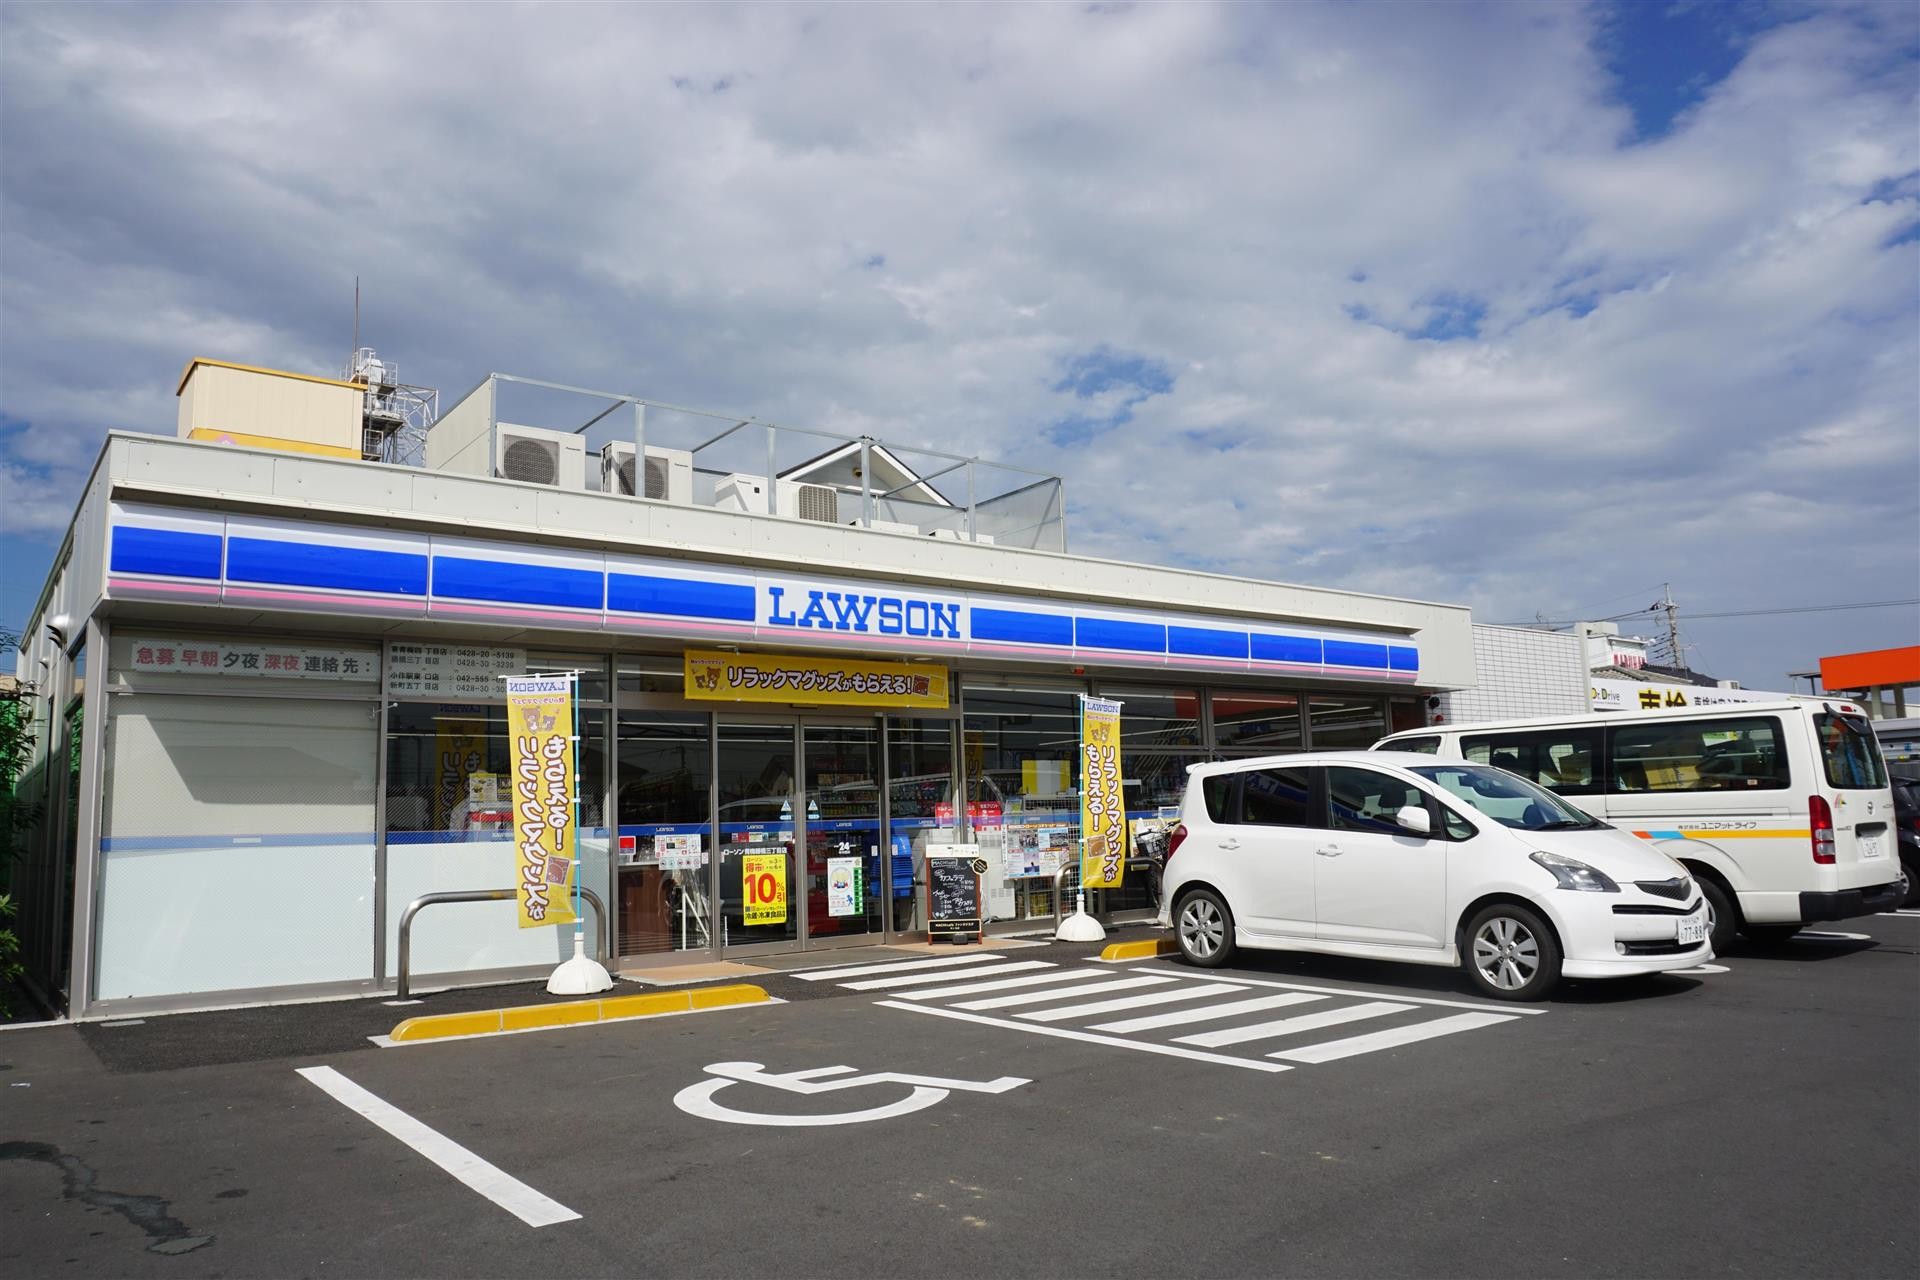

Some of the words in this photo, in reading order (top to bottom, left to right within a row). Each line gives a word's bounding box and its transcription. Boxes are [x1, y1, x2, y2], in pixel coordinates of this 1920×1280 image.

[768, 587, 961, 640] LAWSON
[136, 648, 175, 665] 急募
[181, 649, 218, 667] 早朝
[223, 651, 260, 669] 夕夜
[264, 654, 300, 671] 深夜
[1087, 702, 1119, 714] LAWSON
[1102, 745, 1123, 883] リラックマグッズが
[838, 842, 850, 850] 24
